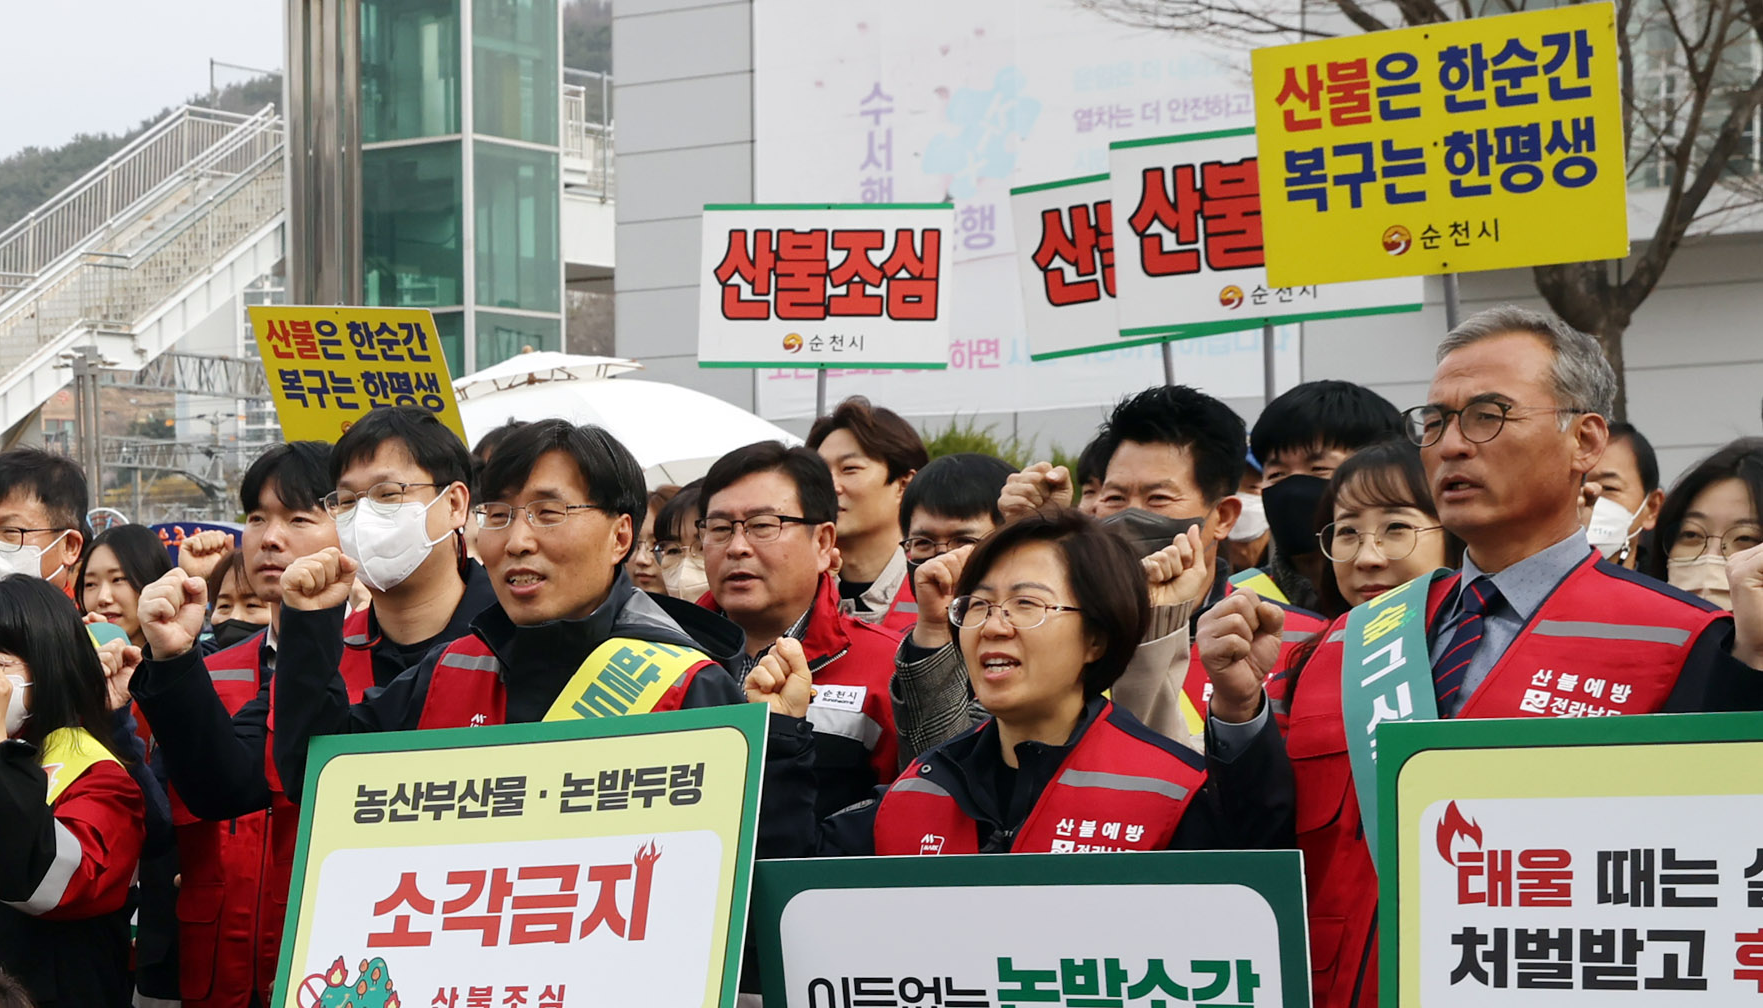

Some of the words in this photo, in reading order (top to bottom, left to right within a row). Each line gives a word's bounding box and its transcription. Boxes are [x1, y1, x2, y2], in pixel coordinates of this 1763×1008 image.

[1275, 52, 1422, 133] 산불은
[1438, 29, 1594, 114] 한순간
[1073, 102, 1135, 133] 열차는
[1142, 98, 1161, 125] 더
[1284, 138, 1427, 213] 복구는
[1443, 115, 1598, 199] 한평생
[1420, 218, 1500, 250] 순천시
[713, 228, 942, 322] 산불조심
[266, 319, 346, 361] 산불은
[346, 320, 432, 363] 한순간
[808, 334, 865, 352] 순천시
[278, 368, 360, 410] 복구는
[360, 371, 446, 413] 한평생
[1532, 668, 1632, 704] 산불예방
[353, 775, 527, 824] 농산부산물
[559, 761, 706, 814] 논밭두렁
[1055, 817, 1145, 843] 산불예방
[365, 848, 665, 948] 소각금지
[1456, 848, 1574, 908] 태울
[1596, 847, 1720, 908] 때는
[1450, 926, 1708, 991] 처벌받고
